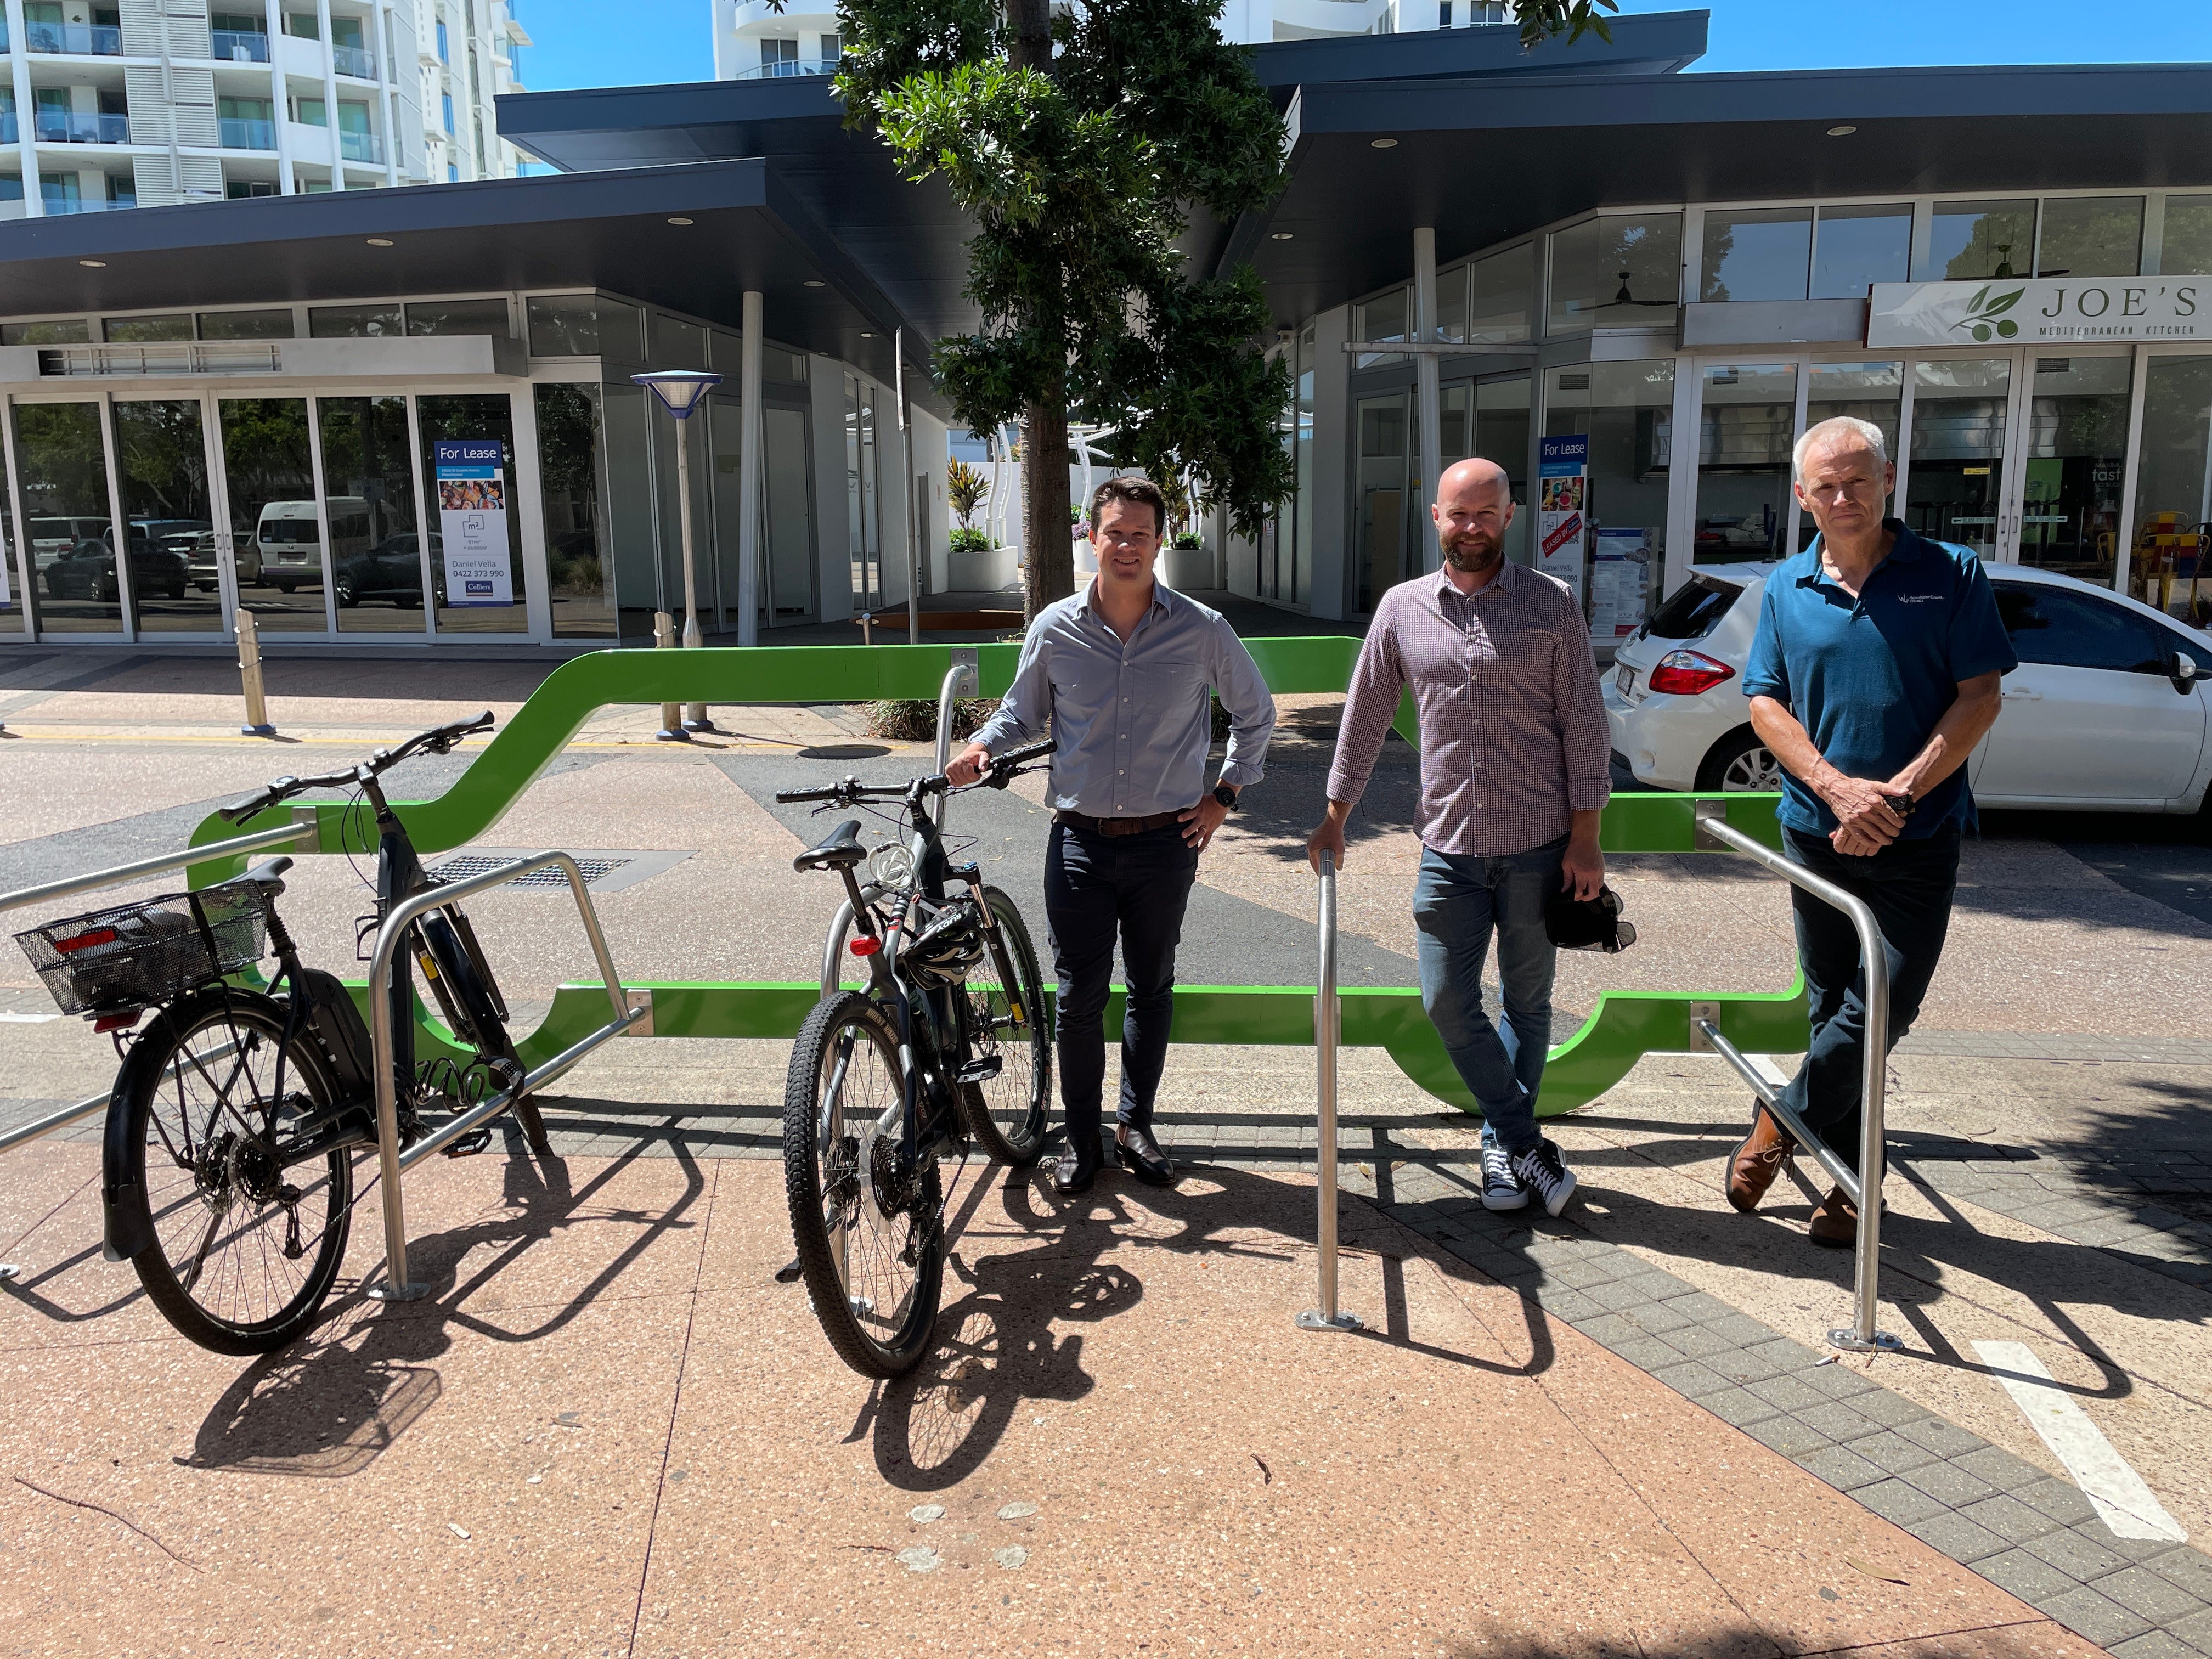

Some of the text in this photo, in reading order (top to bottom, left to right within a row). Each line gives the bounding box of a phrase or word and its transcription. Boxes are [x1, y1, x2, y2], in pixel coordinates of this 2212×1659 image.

[2042, 287, 2196, 318] JOE'S
[2039, 325, 2195, 336] MEDITERRANEAN KITCHEN
[440, 447, 496, 459] For Lease
[1544, 443, 1585, 456] For Lease
[1543, 528, 1568, 553] LEASED BY
[477, 560, 496, 568] Vella
[936, 913, 962, 933] RUDY
